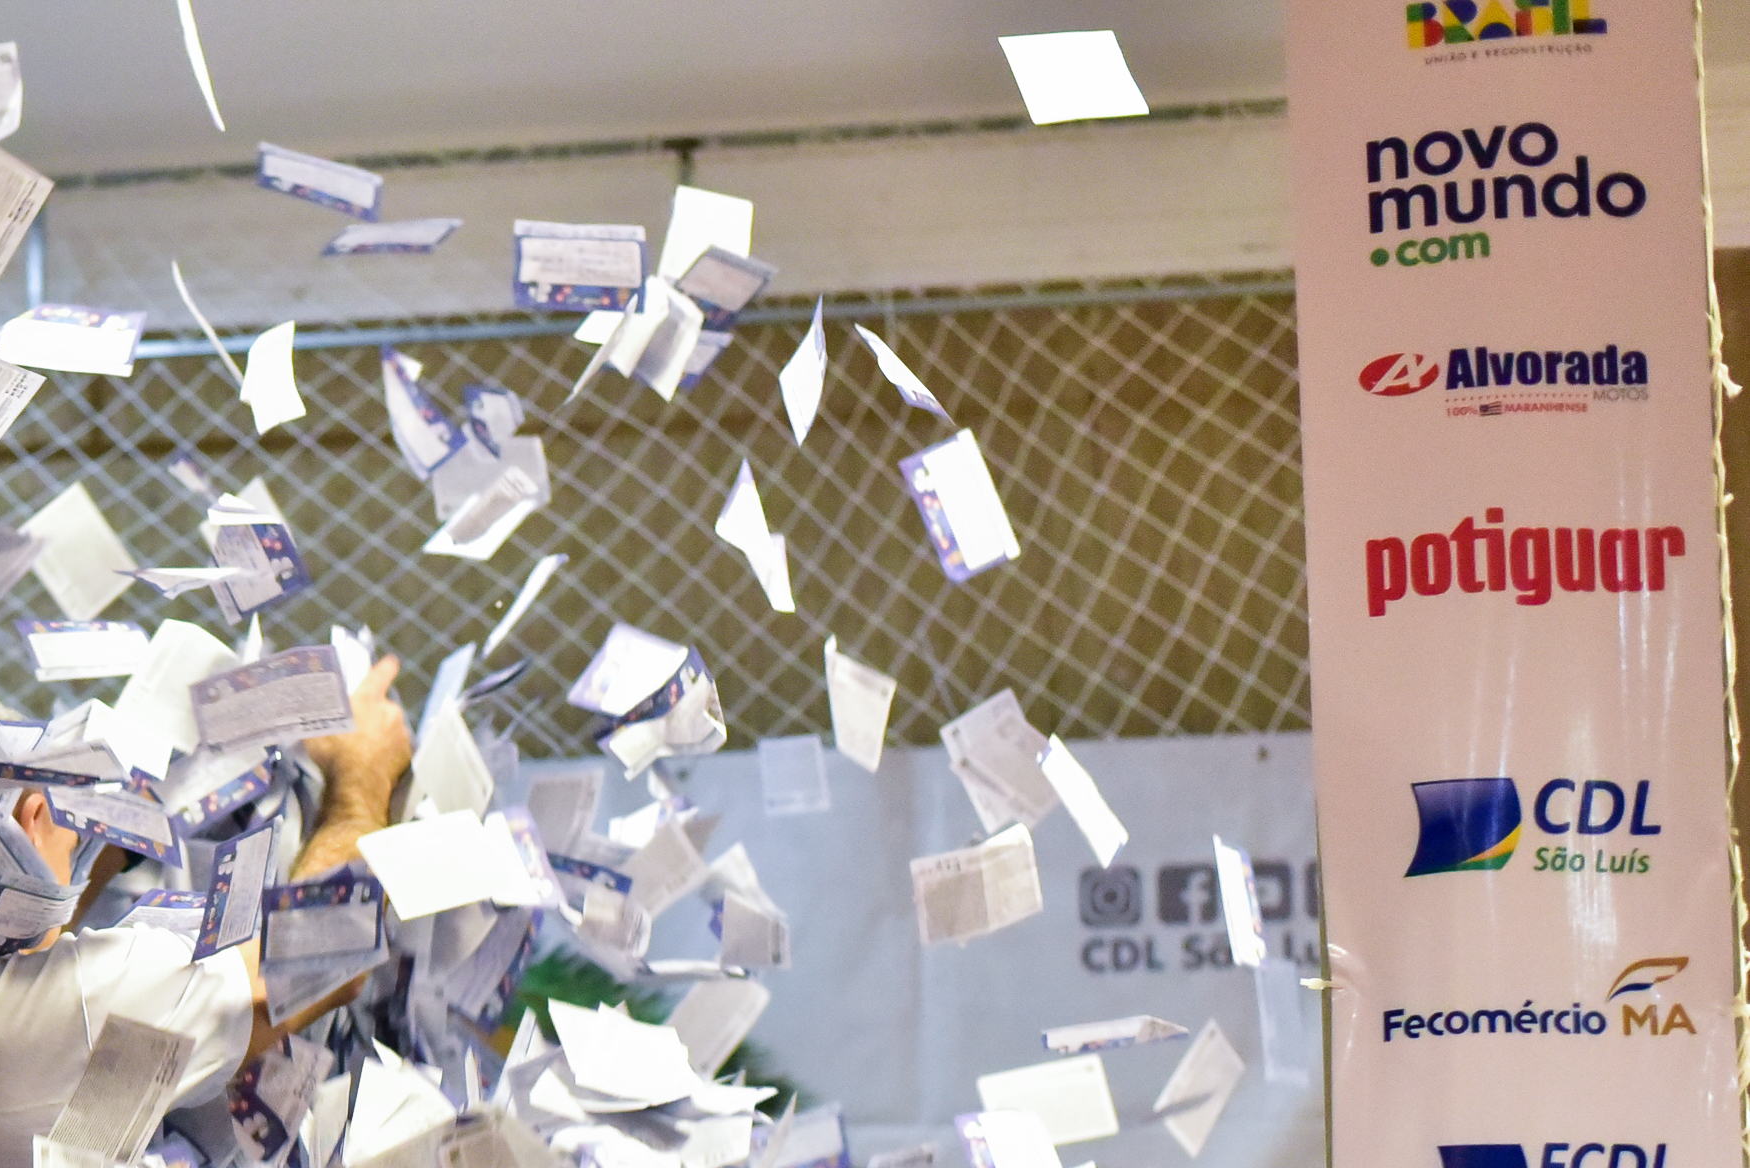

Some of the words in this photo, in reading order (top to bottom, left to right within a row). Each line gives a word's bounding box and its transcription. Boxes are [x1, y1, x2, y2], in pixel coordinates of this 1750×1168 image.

[1366, 122, 1559, 183] novo
[1368, 155, 1647, 233] mundo
[1445, 344, 1648, 390] Alvorada
[1504, 402, 1588, 413] MARANHENSE
[1593, 387, 1648, 401] MOTOS
[1366, 507, 1686, 617] potiguar
[1534, 778, 1662, 836] CDL
[1533, 847, 1585, 873] São
[1595, 847, 1651, 874] Luís
[1082, 936, 1163, 971] CDL
[1383, 1000, 1607, 1042] Fecomércio
[1621, 1003, 1697, 1036] MA
